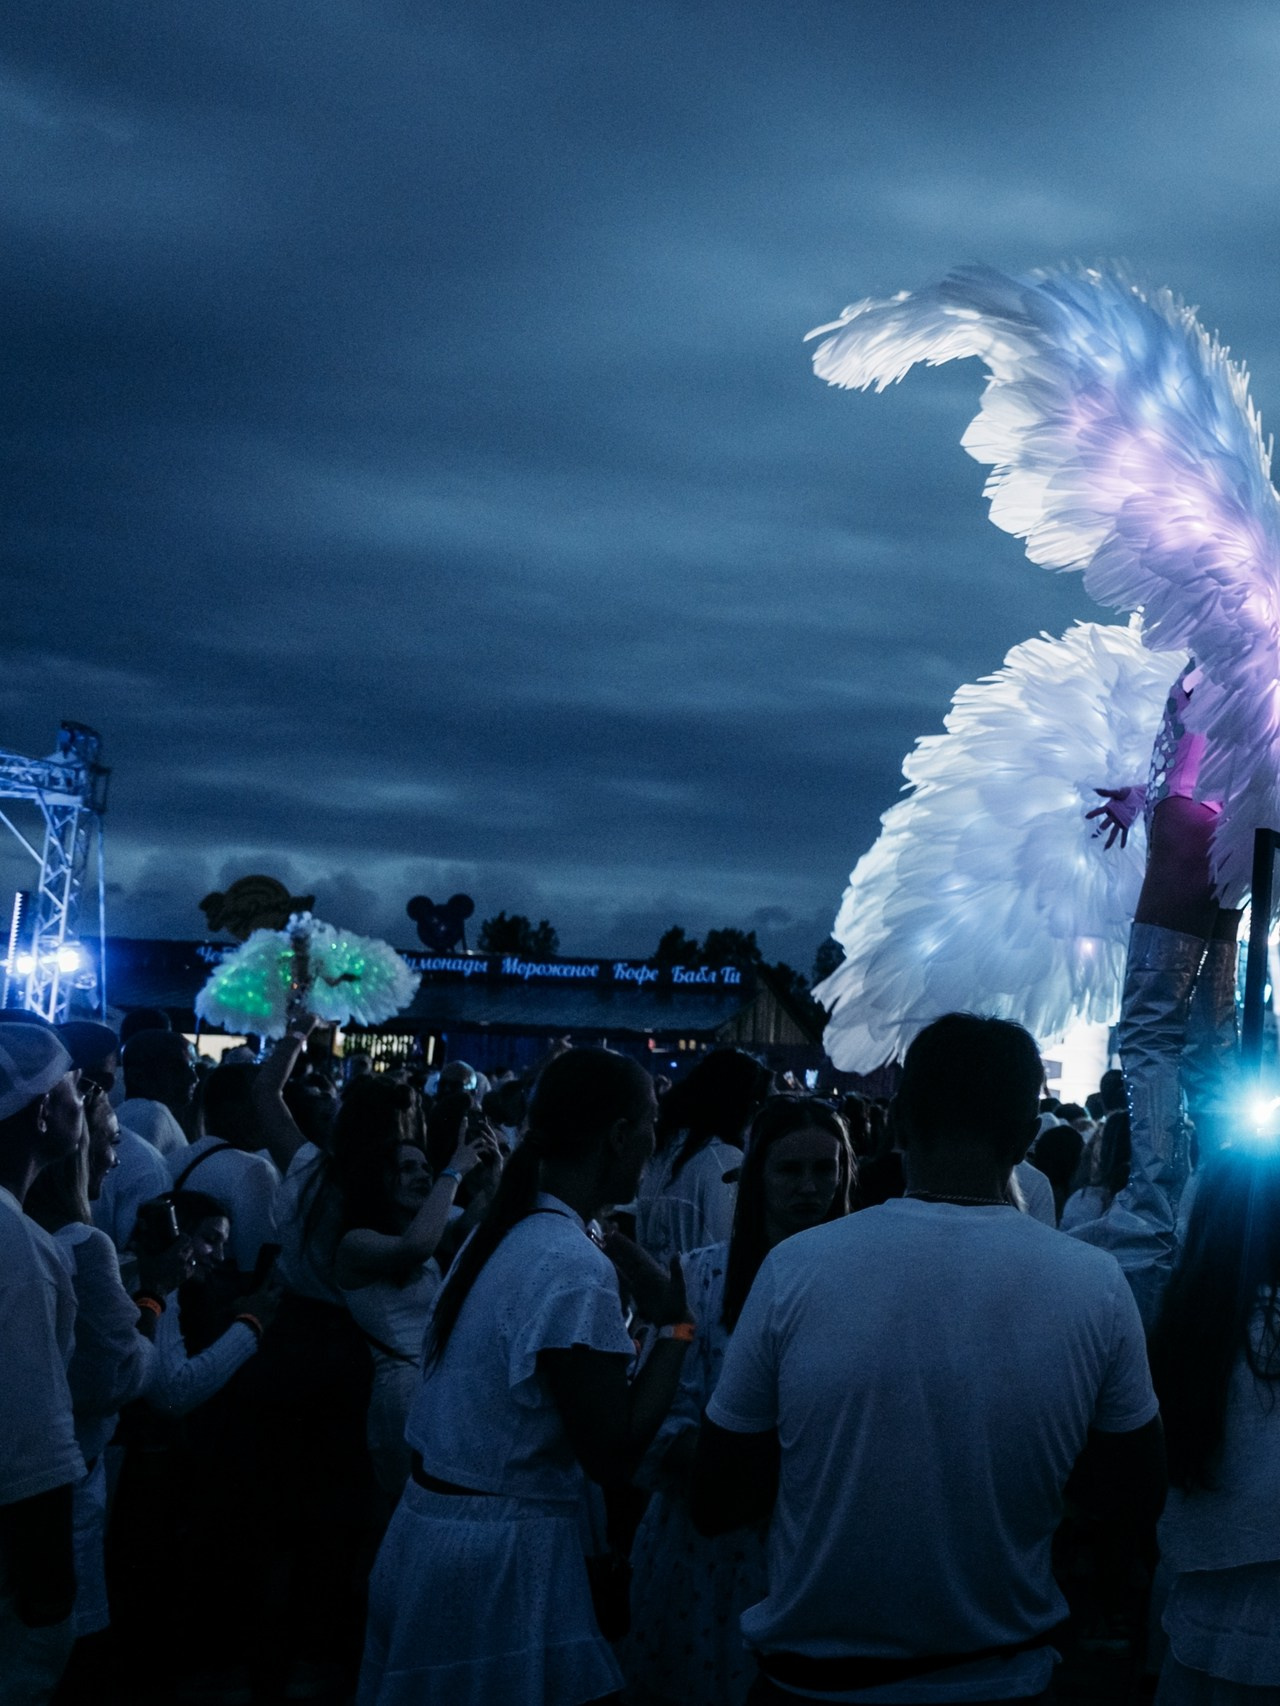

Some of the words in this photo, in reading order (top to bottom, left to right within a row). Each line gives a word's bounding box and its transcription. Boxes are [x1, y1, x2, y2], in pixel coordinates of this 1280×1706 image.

[501, 956, 600, 980] Мороженое
[613, 962, 659, 985] Кофе
[671, 965, 717, 984] Бабл
